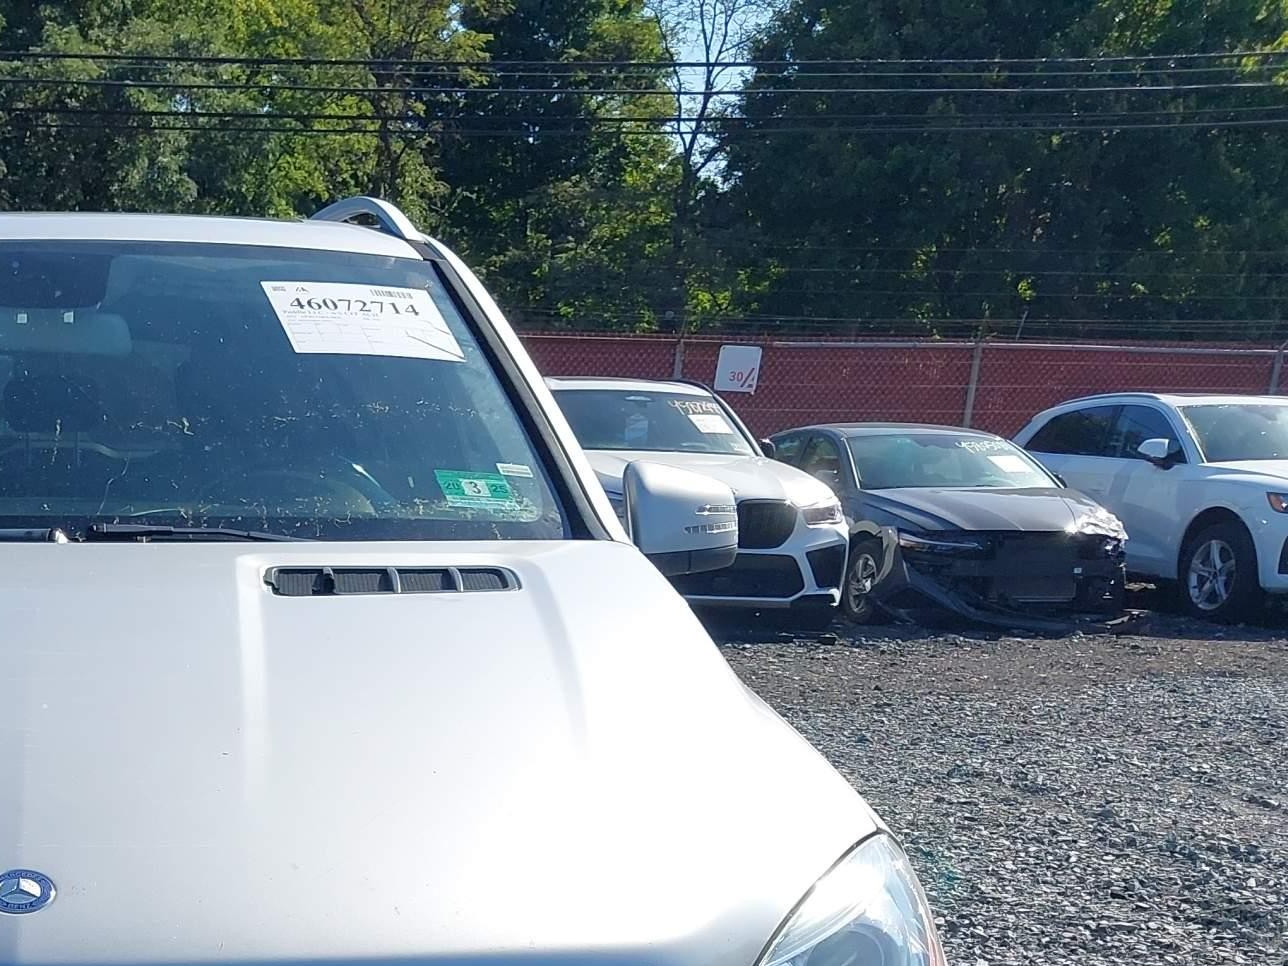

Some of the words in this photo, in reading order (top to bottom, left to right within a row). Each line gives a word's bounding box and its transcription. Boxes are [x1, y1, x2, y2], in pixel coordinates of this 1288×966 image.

[290, 297, 420, 316] 46072714
[469, 481, 481, 494] 3
[491, 484, 509, 493] 25
